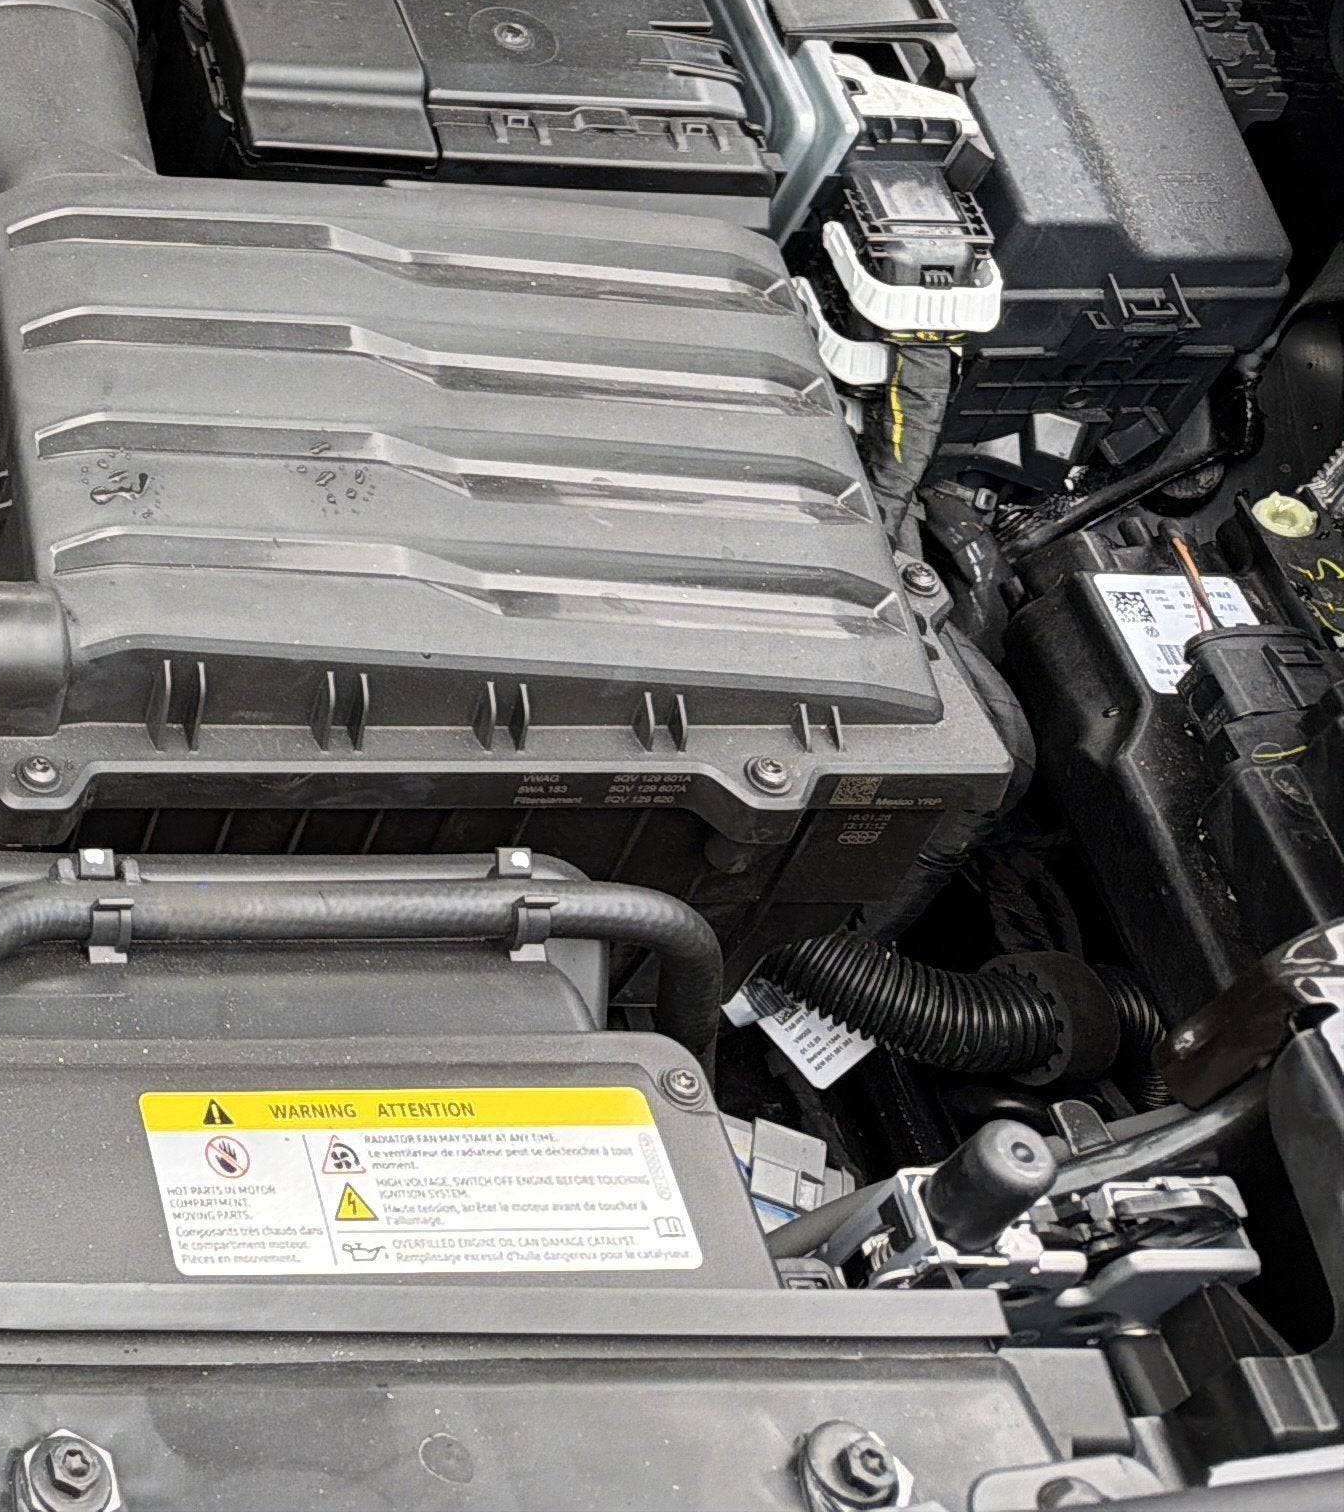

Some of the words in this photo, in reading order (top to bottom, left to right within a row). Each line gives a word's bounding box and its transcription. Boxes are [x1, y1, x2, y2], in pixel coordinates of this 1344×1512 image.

[641, 774, 662, 783] 129
[637, 785, 657, 793] 129
[875, 797, 915, 806] Mexico
[917, 797, 944, 806] YRP
[268, 1103, 358, 1119] WARNING
[377, 1101, 476, 1118] ATTENTION
[363, 1134, 415, 1144] RADIATOR
[416, 1134, 438, 1144] FAN
[439, 1134, 460, 1143] MAY
[462, 1133, 494, 1143] START
[495, 1133, 508, 1143] AT
[368, 1149, 381, 1158] Le
[383, 1148, 439, 1158] ventilateur
[441, 1148, 454, 1158] de
[455, 1148, 504, 1158] radiateur
[505, 1146, 529, 1157] peut
[376, 1177, 403, 1187] HIGH
[454, 1176, 492, 1187] SWITCH
[494, 1176, 515, 1187] OFF
[516, 1176, 554, 1186] ENGINE
[556, 1175, 595, 1186] BEFORE
[167, 1186, 188, 1196] HOT
[190, 1186, 223, 1196] PARTS
[238, 1185, 277, 1195] MOTOR
[172, 1210, 216, 1221] MOVING
[190, 1241, 268, 1253] compartiment
[218, 1255, 231, 1264] en
